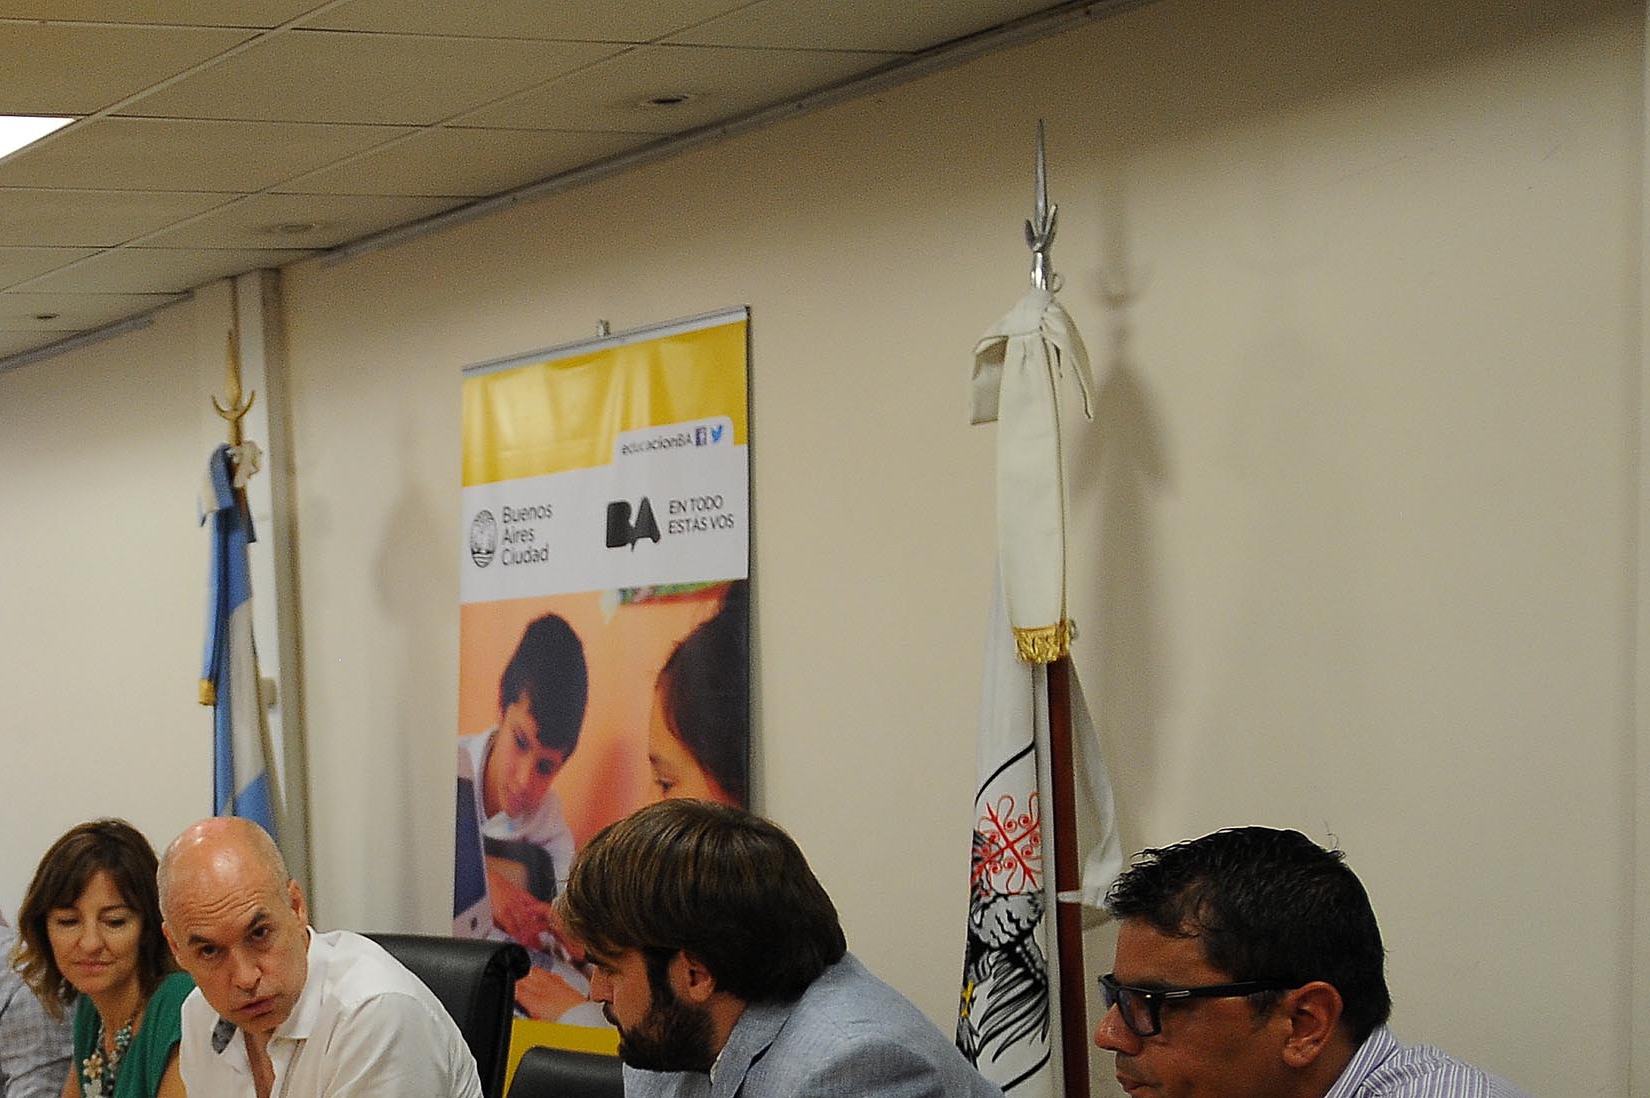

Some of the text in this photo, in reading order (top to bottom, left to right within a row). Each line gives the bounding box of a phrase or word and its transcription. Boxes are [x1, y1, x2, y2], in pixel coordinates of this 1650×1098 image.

[502, 504, 553, 523] Buenos
[669, 495, 723, 514] EN TODO
[606, 497, 661, 550] BA
[710, 513, 734, 529] VOS
[502, 526, 534, 545] Aires
[501, 544, 549, 566] Ciudad
